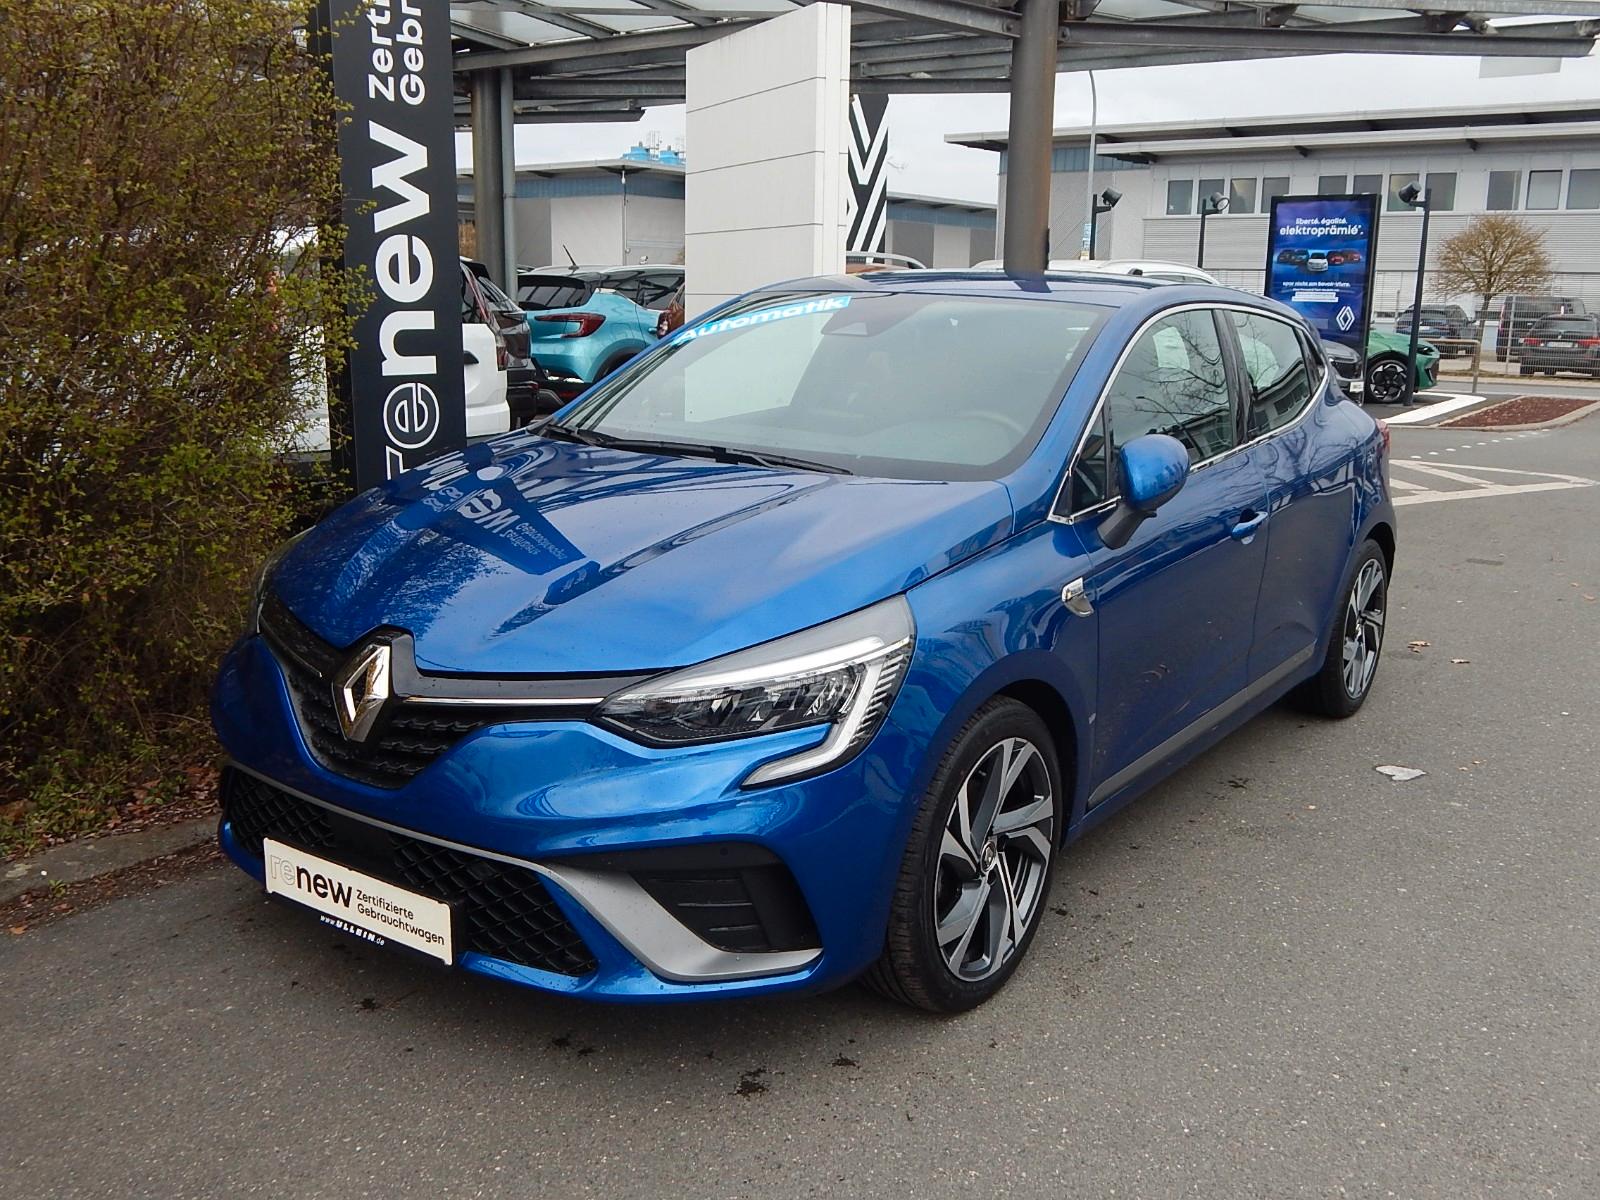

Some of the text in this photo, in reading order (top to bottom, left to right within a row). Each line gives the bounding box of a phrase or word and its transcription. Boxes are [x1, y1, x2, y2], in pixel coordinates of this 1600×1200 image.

[674, 296, 844, 344] Automatik
[270, 854, 352, 908] renew
[356, 889, 414, 920] Zertifizierte
[357, 903, 445, 945] Gebrauchtwagen
